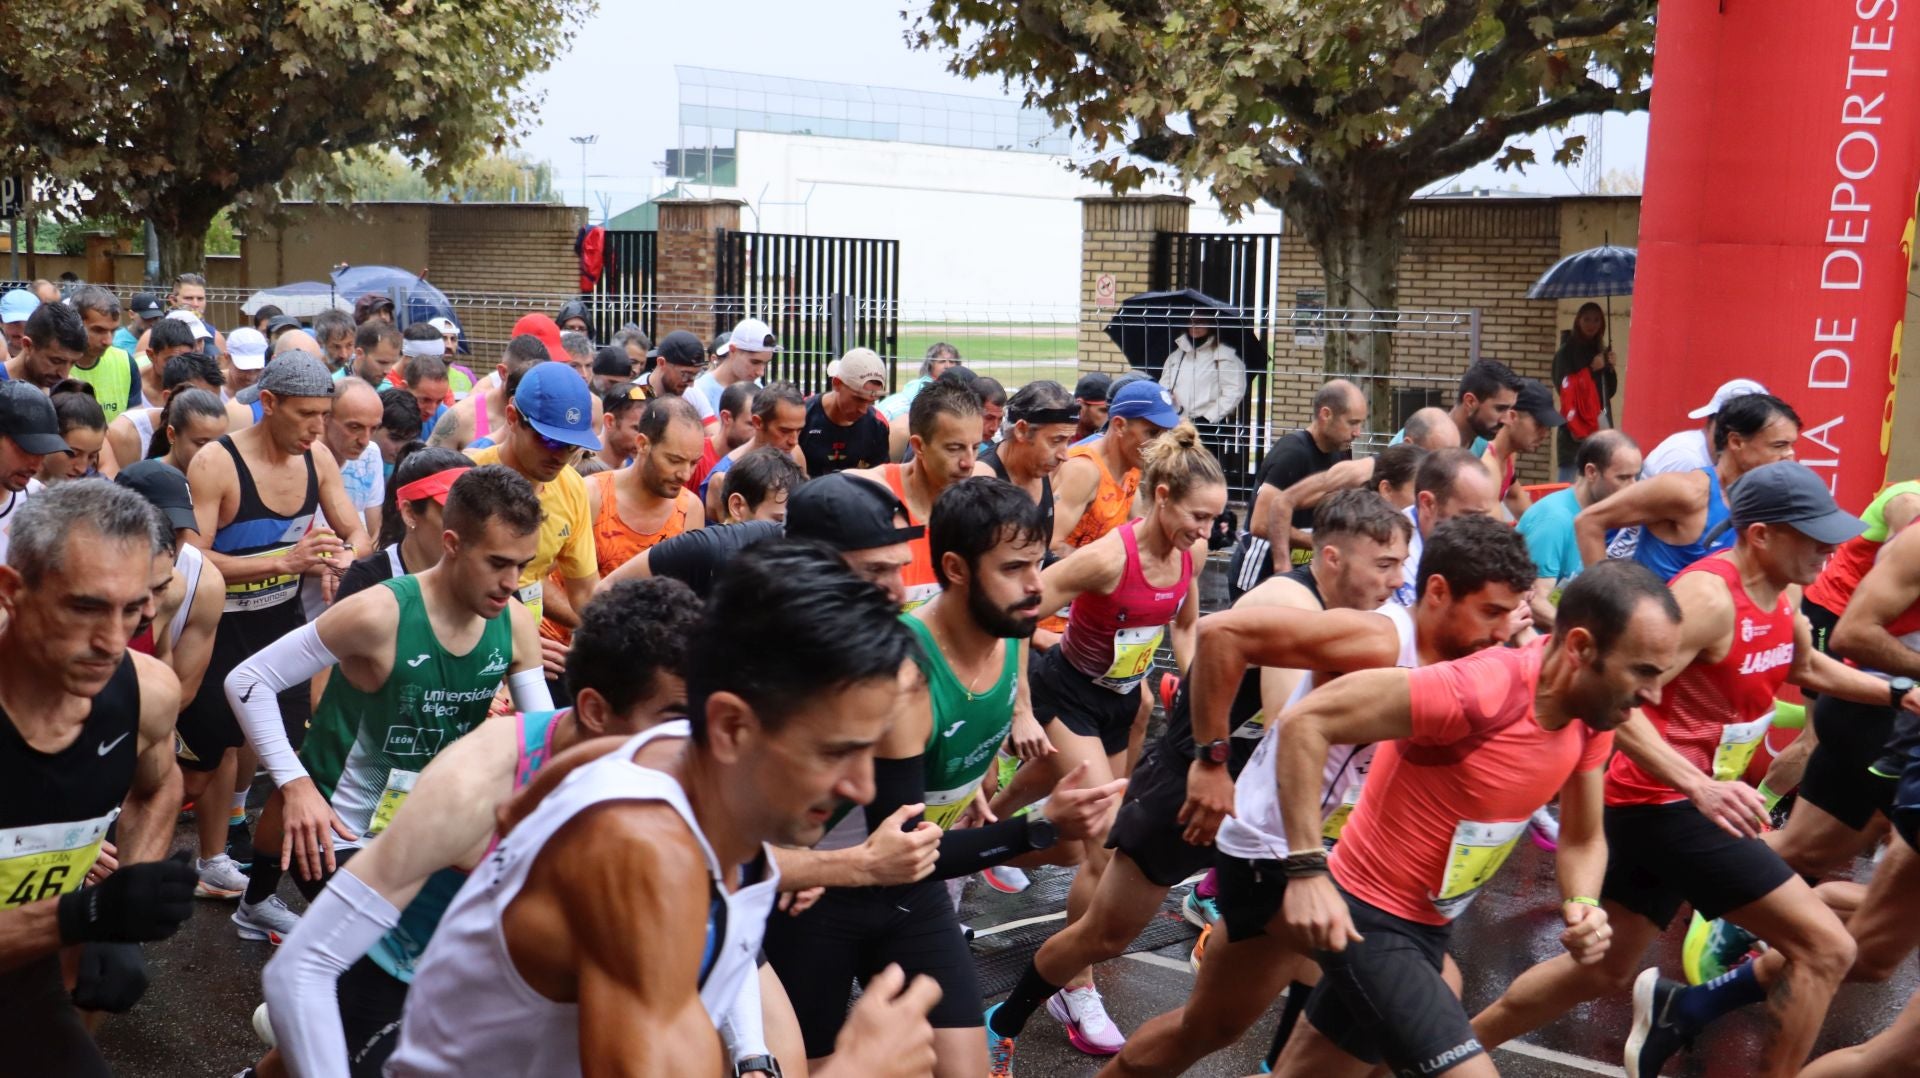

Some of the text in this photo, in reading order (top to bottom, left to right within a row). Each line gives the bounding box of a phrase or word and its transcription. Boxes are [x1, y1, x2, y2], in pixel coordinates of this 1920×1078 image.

[1820, 0, 1899, 291] DEPORTES
[1, 176, 15, 216] P
[1807, 317, 1857, 390] DE
[253, 591, 288, 605] HYUNDAI
[390, 734, 414, 744] LEÓN
[5, 864, 71, 906] 46
